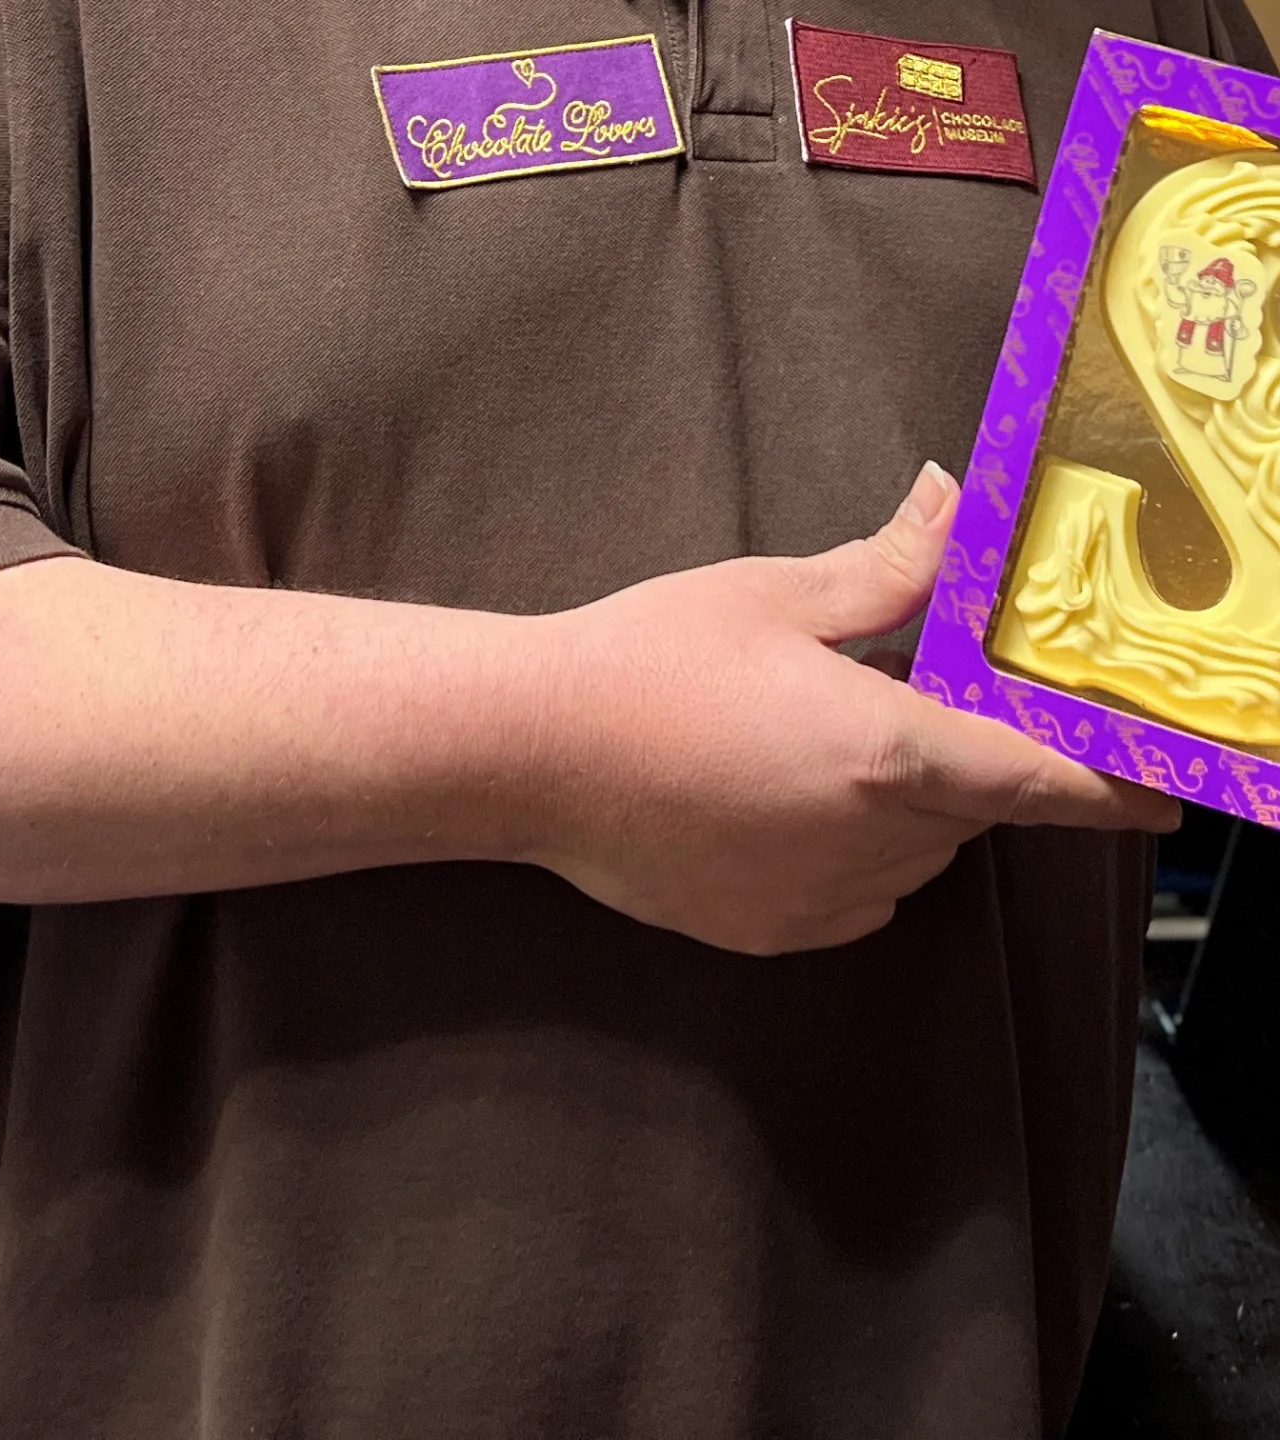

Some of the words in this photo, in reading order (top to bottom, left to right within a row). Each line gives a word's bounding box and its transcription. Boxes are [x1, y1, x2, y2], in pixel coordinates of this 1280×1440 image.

[407, 104, 553, 177] Chocolate
[561, 100, 658, 155] Lovers
[944, 127, 1006, 144] MUSEUM
